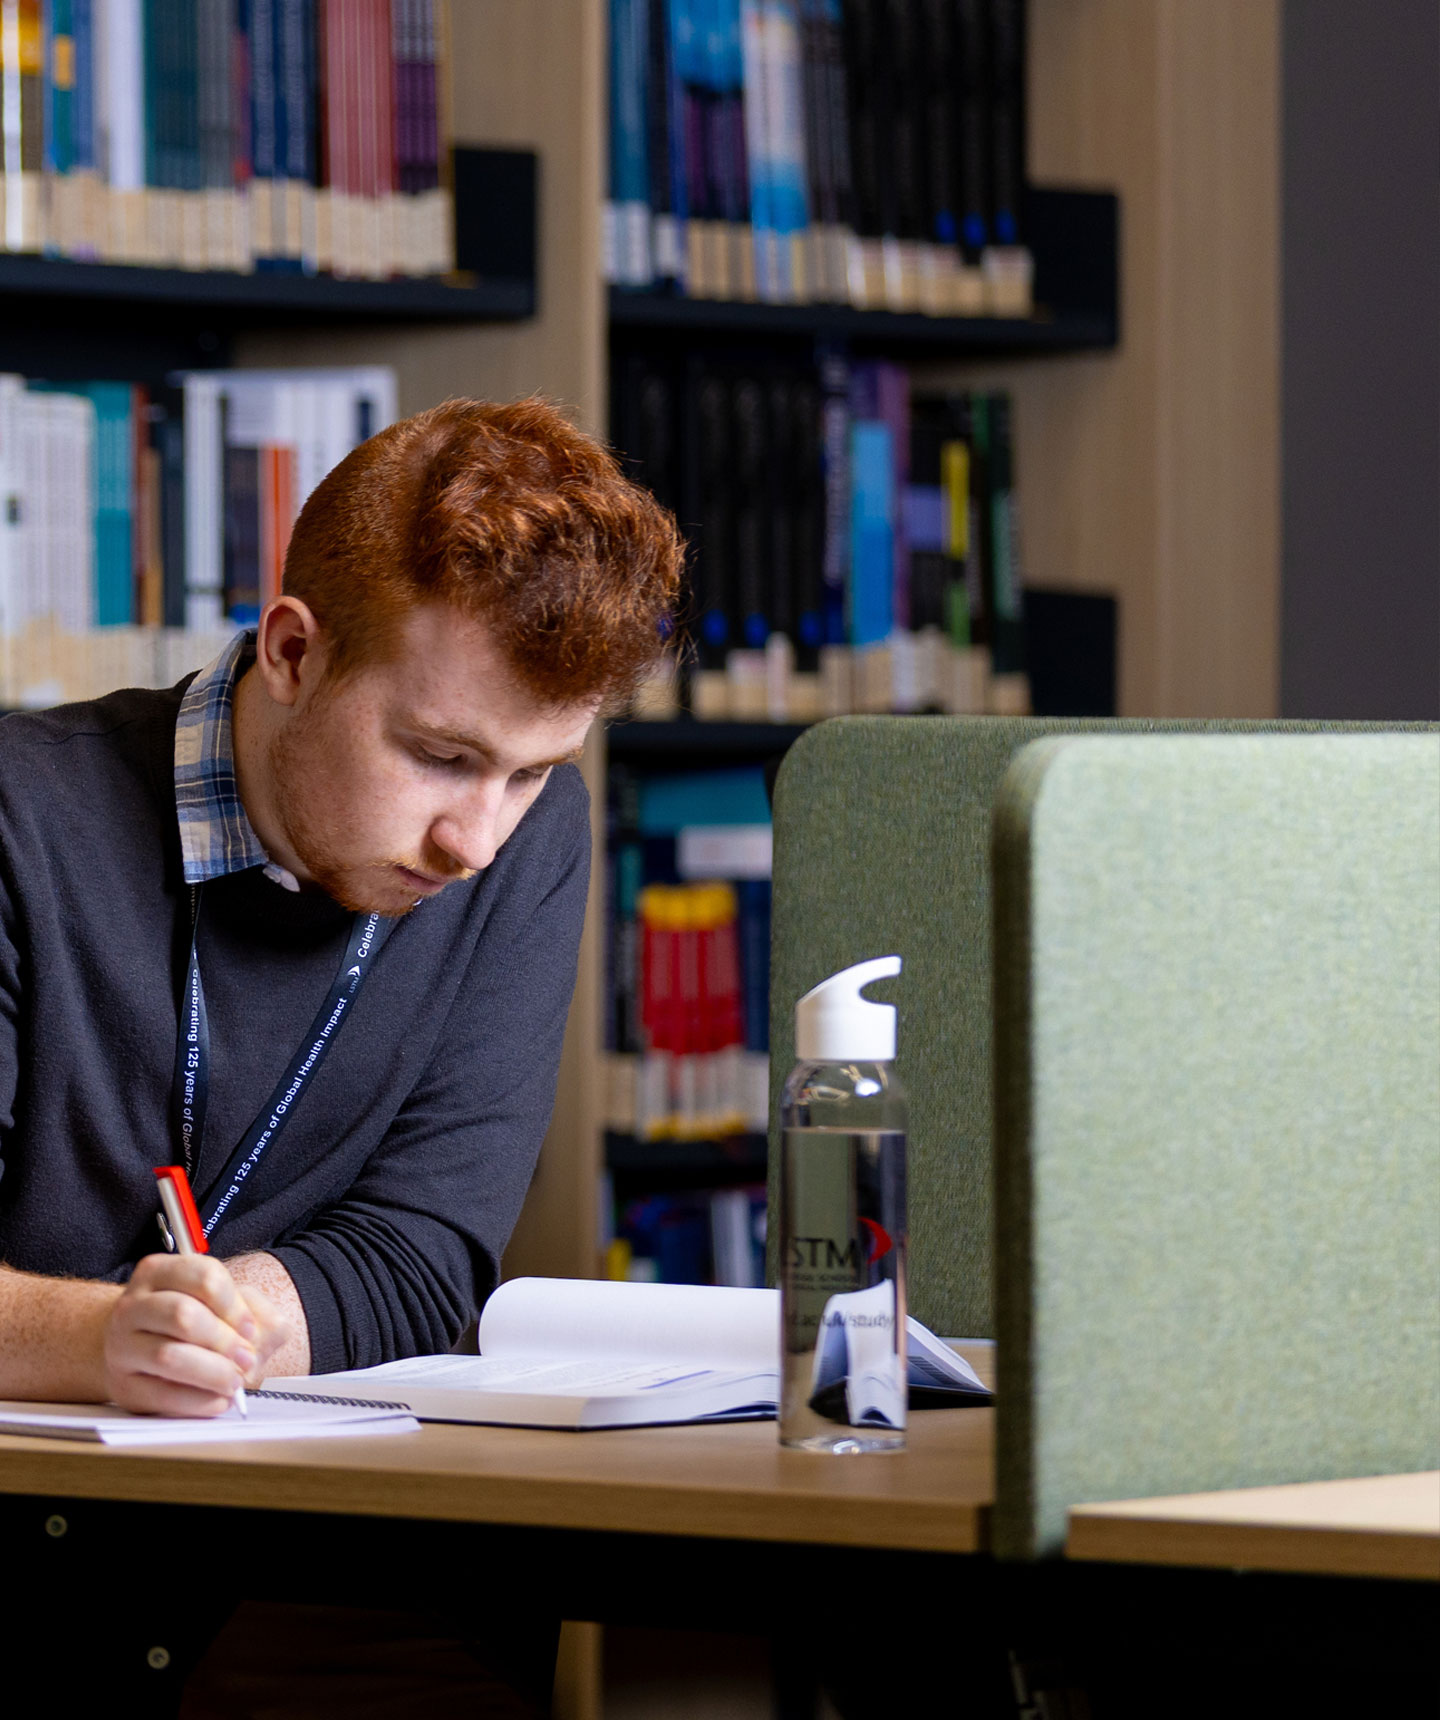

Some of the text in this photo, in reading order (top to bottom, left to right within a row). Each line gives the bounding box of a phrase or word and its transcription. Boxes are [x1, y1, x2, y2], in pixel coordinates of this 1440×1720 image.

[357, 910, 380, 958] Celebra
[187, 968, 201, 1042] Celebrating
[187, 1046, 200, 1069] 125
[183, 1070, 196, 1105] years
[183, 1107, 194, 1120] of
[202, 997, 348, 1239] elebrating 125 years of Global Health Impact
[182, 1120, 193, 1160] Global
